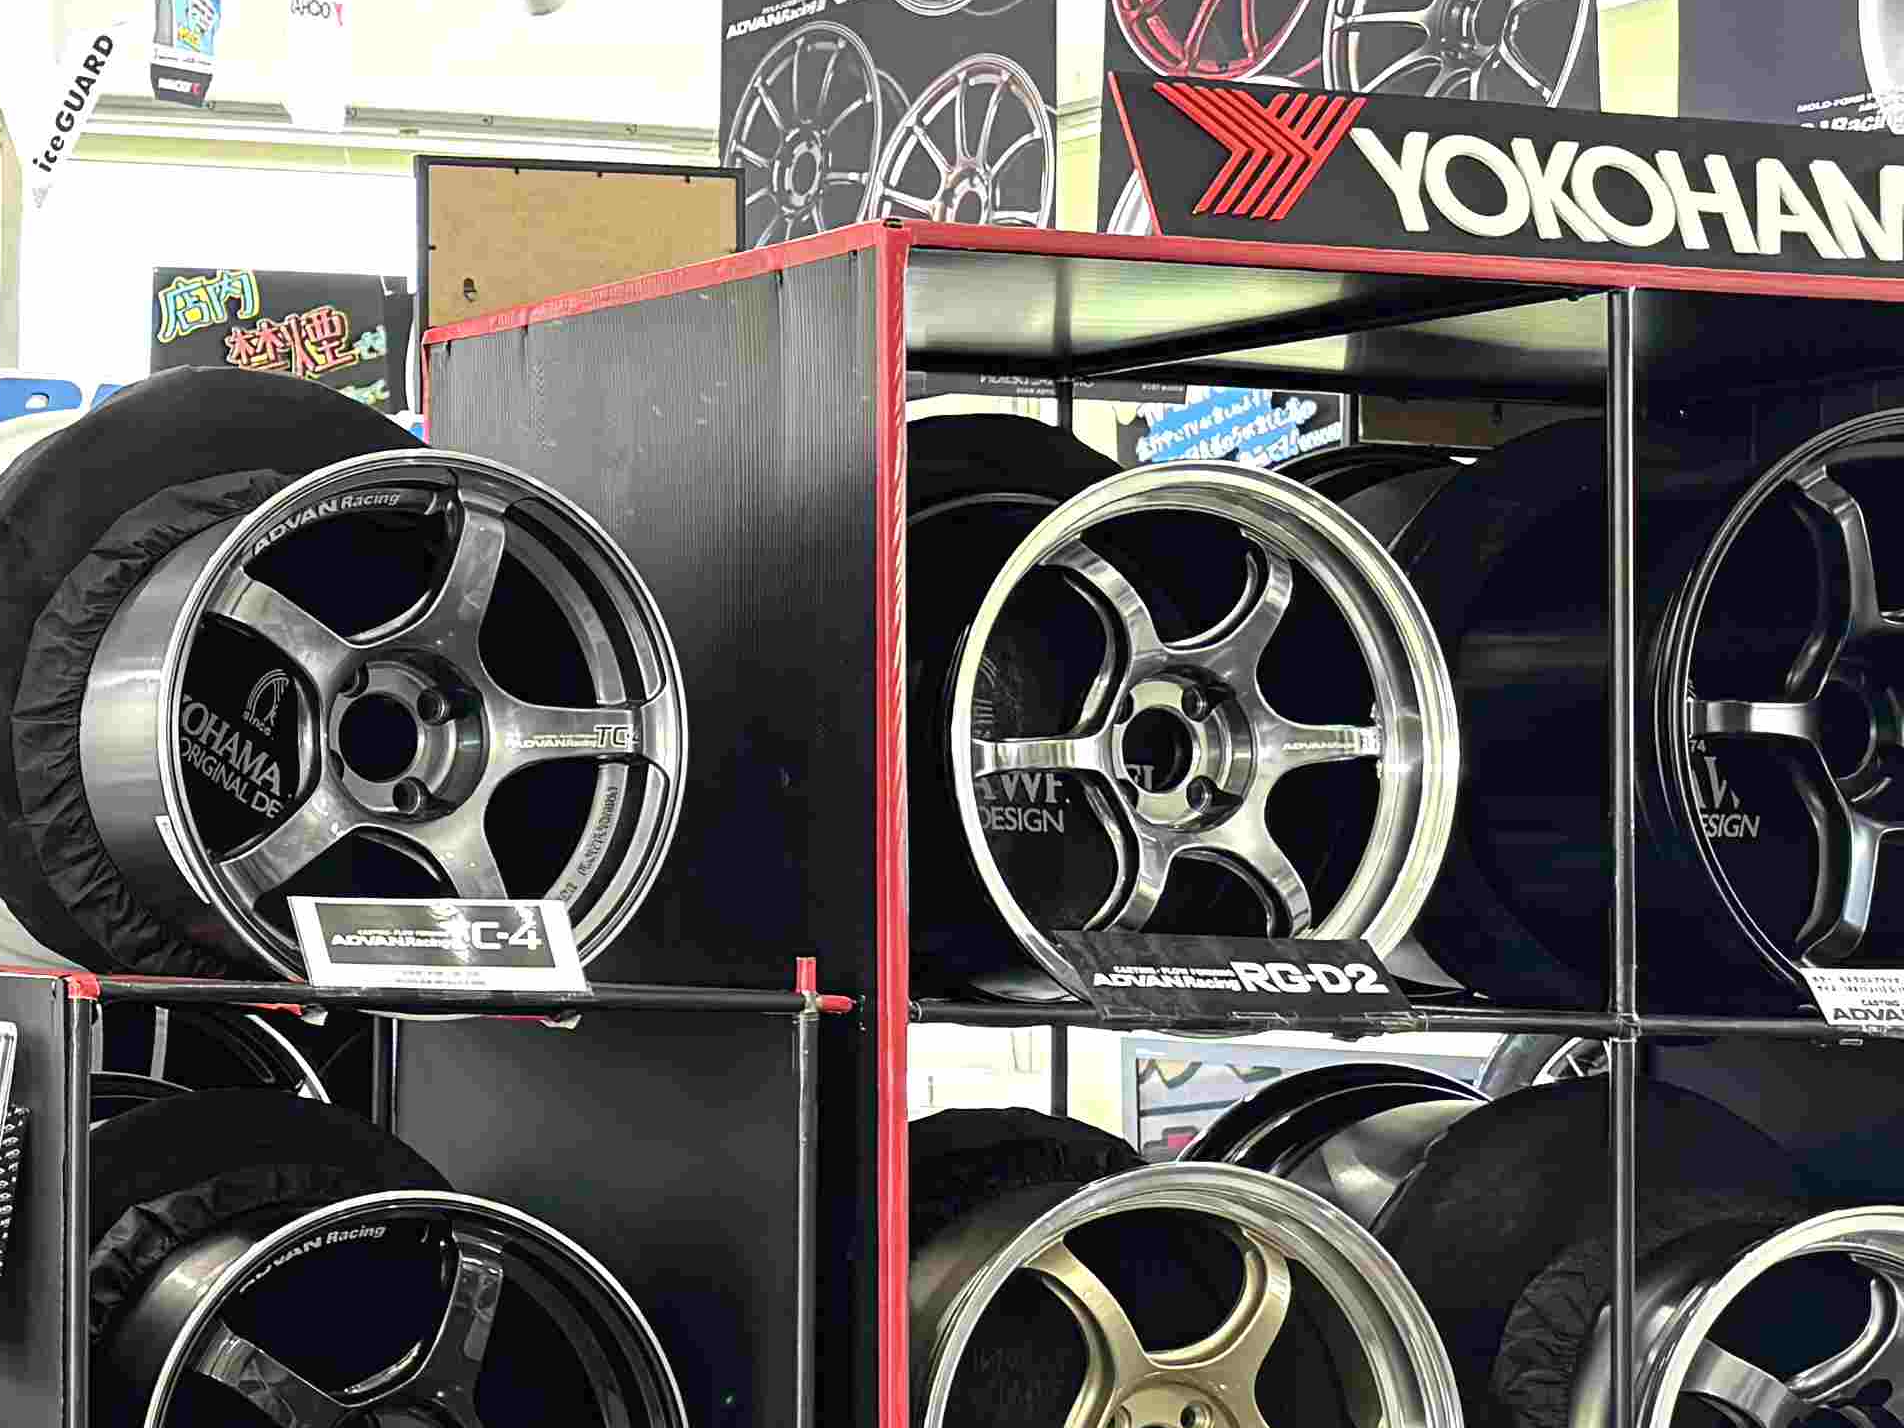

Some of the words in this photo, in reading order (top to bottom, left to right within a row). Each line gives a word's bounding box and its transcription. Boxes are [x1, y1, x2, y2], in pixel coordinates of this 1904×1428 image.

[31, 32, 116, 173] iceGUARD
[1349, 127, 1904, 263] YOKOHAM
[159, 270, 261, 343] 店内
[253, 498, 339, 555] ADVAN
[341, 493, 401, 510] Racing
[182, 694, 280, 796] OHAMA
[331, 934, 400, 946] ADVAN
[1093, 973, 1186, 988] ADVAN
[1230, 961, 1390, 994] RG-D2
[326, 1224, 387, 1244] Racing
